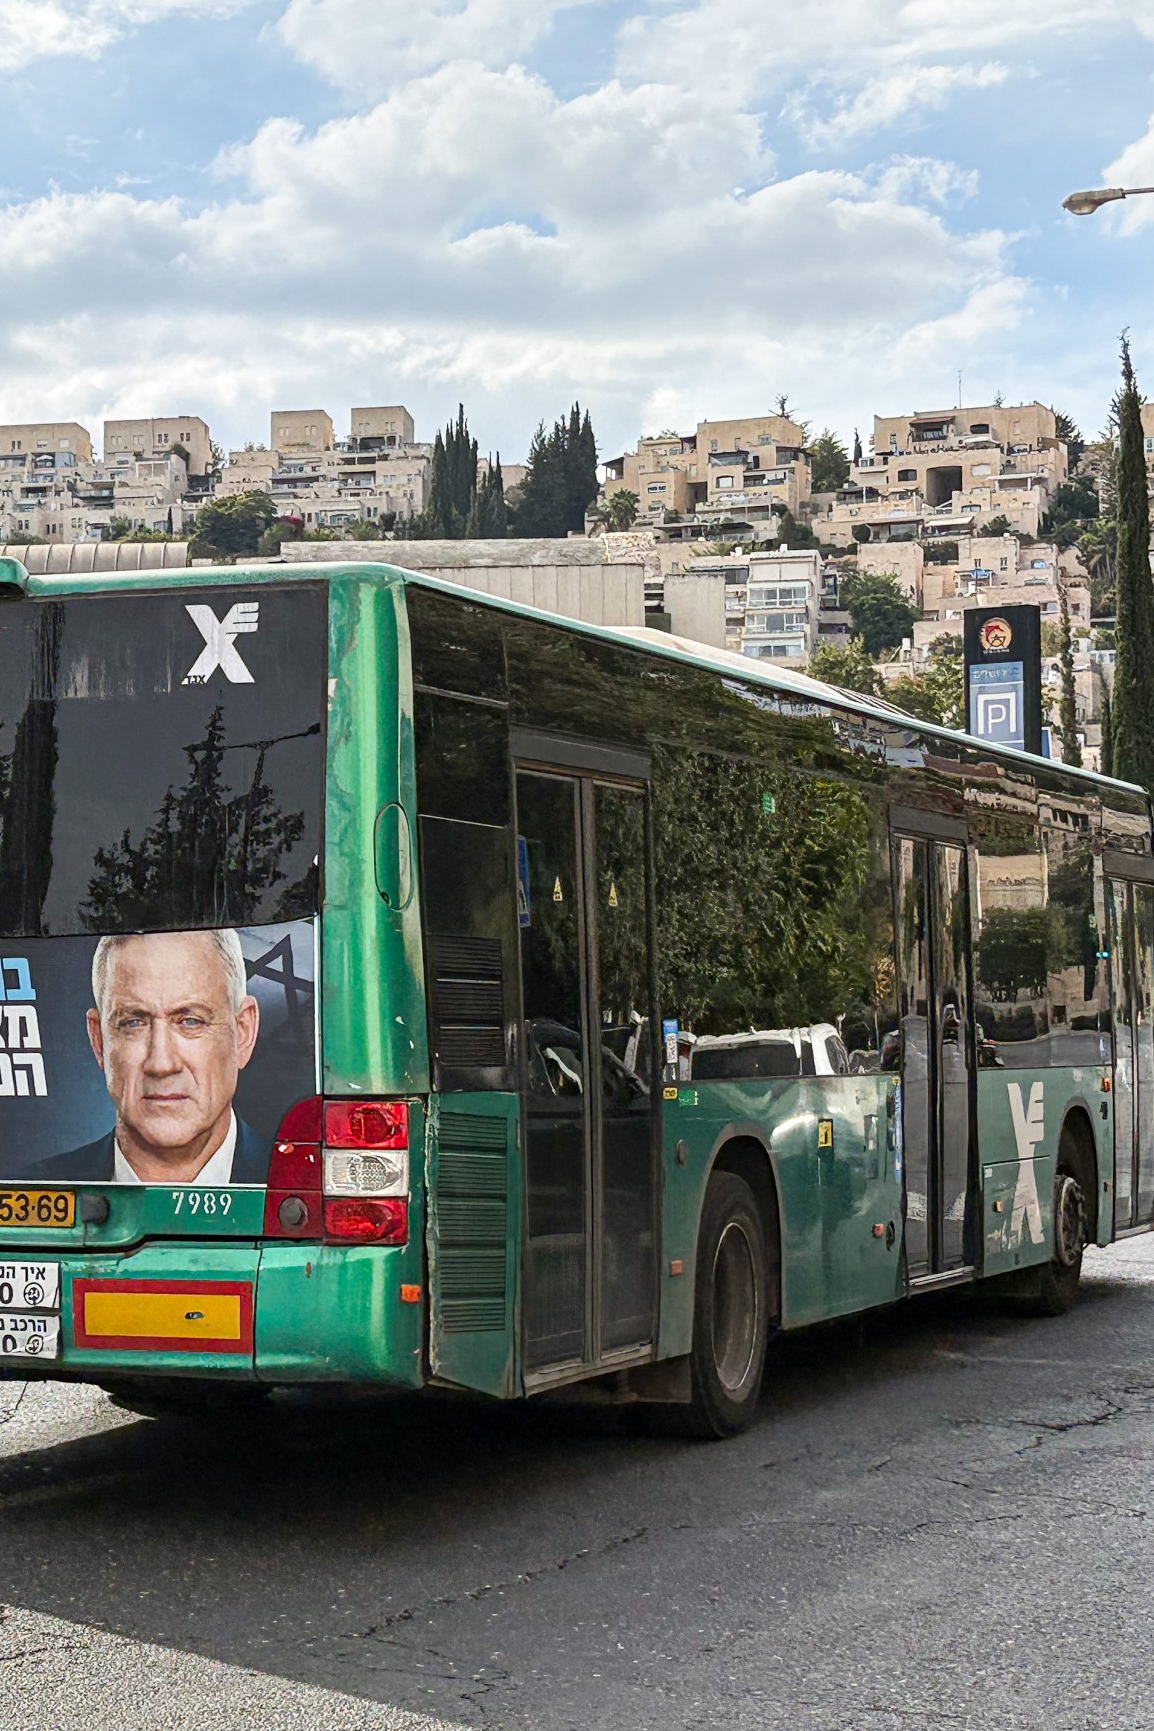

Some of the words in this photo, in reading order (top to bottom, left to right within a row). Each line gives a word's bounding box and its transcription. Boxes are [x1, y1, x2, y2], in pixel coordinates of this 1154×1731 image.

[988, 704, 1006, 734] P
[172, 1191, 232, 1216] 7989
[20, 1266, 46, 1282] איך
[10, 1319, 47, 1332] הרכב
